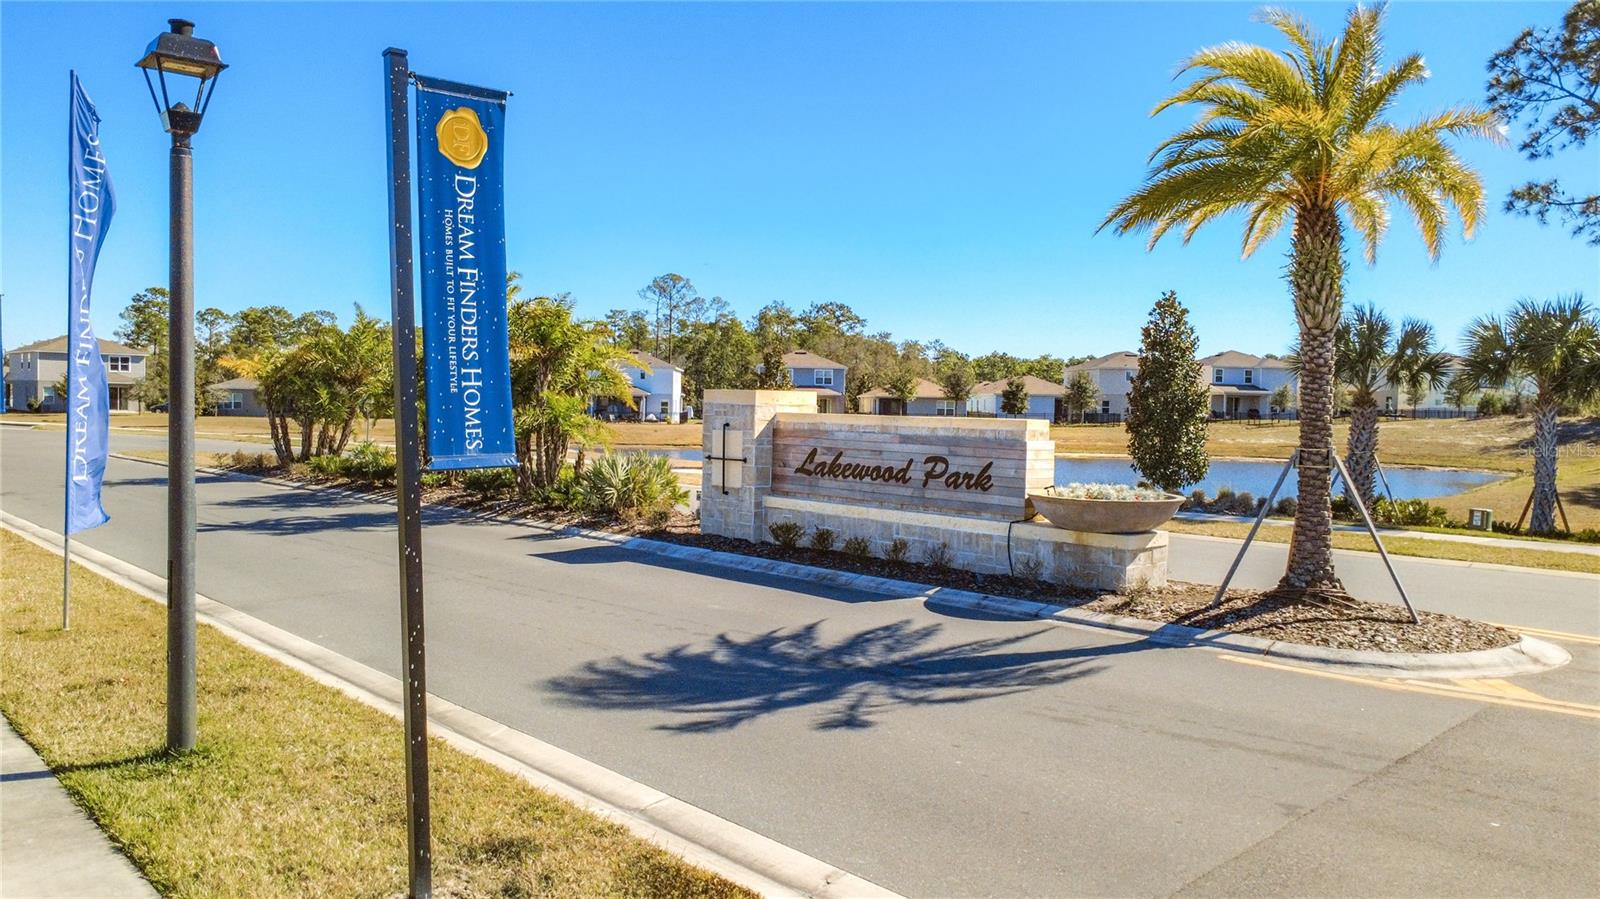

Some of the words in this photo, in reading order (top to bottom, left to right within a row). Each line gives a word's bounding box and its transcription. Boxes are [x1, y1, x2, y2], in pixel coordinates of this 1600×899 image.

[444, 209, 454, 246] HOMES
[454, 174, 476, 260] DREAM
[445, 250, 454, 277] BUILT
[446, 279, 455, 295] TO
[447, 298, 455, 312] FIT
[447, 314, 456, 343] YOUR
[457, 267, 479, 361] FINDERS
[448, 346, 458, 393] LIFESTYLE
[73, 376, 90, 482] DREAM
[461, 368, 483, 449] HOMES
[794, 448, 913, 484] Lakewood
[922, 456, 994, 491] Park
